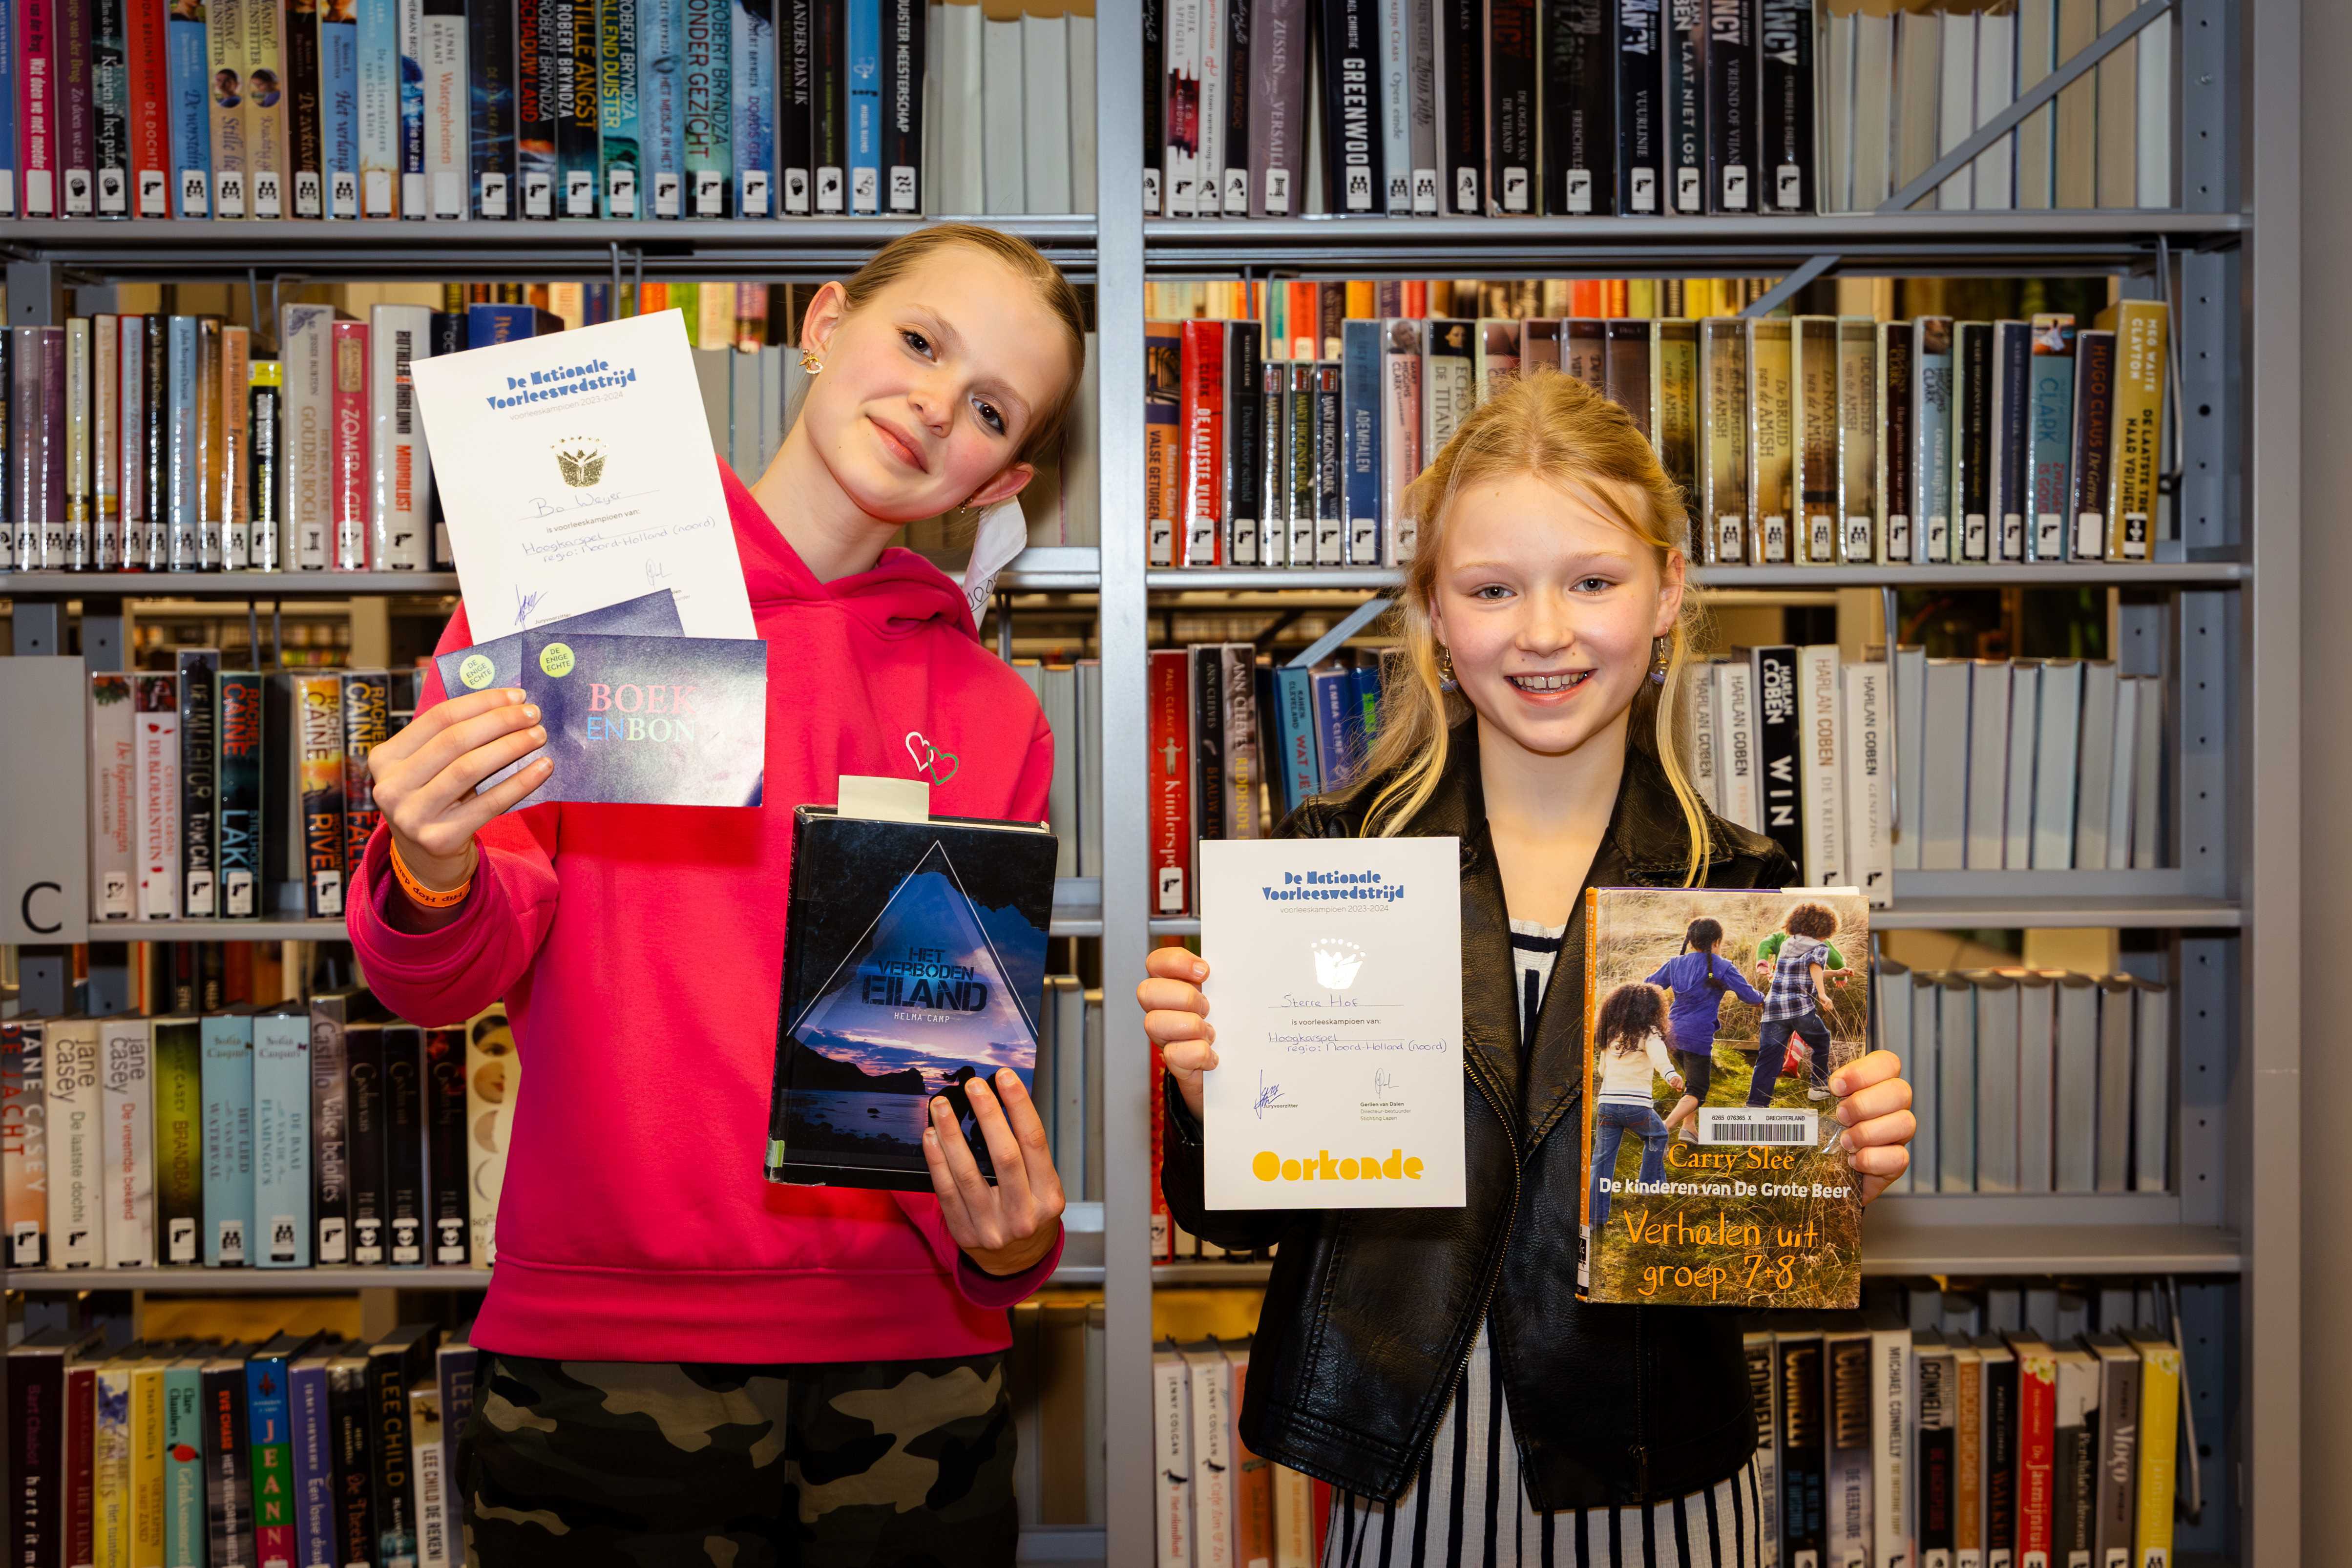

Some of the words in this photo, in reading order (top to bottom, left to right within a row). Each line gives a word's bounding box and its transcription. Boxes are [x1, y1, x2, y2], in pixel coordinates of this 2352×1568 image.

[433, 23, 443, 65] BRYANT
[445, 27, 456, 62] LYNNE
[557, 3, 573, 54] ROBERT
[30, 58, 45, 75] Wat
[794, 57, 808, 87] DAN
[1682, 42, 1694, 84] LAAT
[30, 77, 46, 99] doen
[30, 101, 44, 115] we
[521, 79, 540, 122] LAND
[539, 56, 556, 122] BRYNDZA
[558, 58, 574, 118] BRYNDZA
[574, 62, 598, 132] ANGST
[603, 61, 621, 128] DUISTER
[620, 52, 637, 121] BRYNDZA
[711, 67, 730, 146] BRYNDZA
[795, 90, 809, 105] IK
[896, 44, 911, 133] MEESTERSCHAP
[1683, 89, 1696, 127] NIET
[31, 116, 46, 134] met
[437, 71, 455, 164] Watergeheimen
[687, 73, 710, 159] GEZICHT
[1343, 58, 1369, 165] GREENWOO
[31, 136, 48, 169] moeder
[1683, 133, 1696, 165] LOS
[2130, 318, 2143, 380] CLAYTON
[2146, 319, 2158, 346] MEG
[486, 368, 637, 411] Voorleeswedstrijd
[507, 375, 527, 391] De
[530, 358, 609, 385] Nationale
[2090, 345, 2107, 394] HUGO
[2144, 352, 2156, 392] WAITE
[509, 399, 580, 422] voorleeskampioen
[580, 390, 624, 407] 2023-2024
[1197, 408, 1211, 426] DE
[1776, 398, 1789, 446] BRUID
[2036, 377, 2060, 443] CLARK
[2088, 398, 2105, 446] CLAUS
[2142, 409, 2153, 426] DE
[301, 406, 317, 475] GOUDEN
[1149, 430, 1161, 464] VALSE
[1197, 429, 1211, 479] LAATSTE
[1355, 409, 1370, 473] ADEMHALEN
[1759, 408, 1774, 458] AMISH
[2124, 418, 2138, 454] NAAR
[396, 445, 413, 512] MOORDLUST
[2139, 429, 2153, 485] LAATSTE
[543, 548, 579, 563] regio:
[672, 516, 716, 536] (noord)
[553, 513, 624, 532] voorleeskampioen
[624, 508, 641, 519] van:
[522, 533, 604, 555] Hoogkarspel
[466, 662, 487, 679] ENIGE
[468, 658, 479, 669] DE
[546, 651, 568, 664] ENIGE
[546, 659, 571, 671] ECHTE
[550, 647, 561, 655] DE
[470, 668, 493, 686] ECHTE
[1233, 661, 1246, 692] ANN
[1762, 658, 1784, 725] COBEN
[1780, 665, 1794, 715] HARLAN
[1815, 658, 1831, 714] HARLAN
[223, 683, 246, 756] CAINE
[245, 688, 260, 748] RACHEL
[345, 682, 370, 756] CAINE
[588, 683, 697, 715] BOEK
[1731, 676, 1746, 728] HARLAN
[1864, 676, 1876, 727] HARLAN
[305, 692, 327, 761] CAINE
[326, 695, 342, 753] RACHEL
[587, 715, 695, 743] ENBON
[1234, 696, 1249, 752] CLEEVES
[1818, 718, 1834, 767] COBEN
[116, 741, 132, 760] De
[148, 739, 162, 756] DE
[1296, 734, 1309, 765] WAT
[1734, 731, 1748, 776] COBEN
[1865, 731, 1877, 776] COBEN
[1235, 757, 1251, 831] REDDENDE
[1298, 772, 1311, 788] JE
[1769, 755, 1794, 827] WIN
[111, 764, 131, 853] bijenkoningin
[148, 760, 162, 861] BLOEMENTUIN
[413, 887, 436, 903] Hop
[441, 891, 463, 902] Hip
[1262, 884, 1405, 902] Voorleeswedstrijd
[1284, 871, 1302, 885] De
[1307, 870, 1382, 885] Nationale
[21, 881, 62, 935] C
[1280, 906, 1347, 914] voorleeskampioen
[1347, 904, 1389, 913] 2023-2024
[879, 960, 974, 982] VERBODEN
[908, 947, 945, 964] HET
[861, 976, 988, 1012] EILAND
[1281, 994, 1322, 1008] Sterre
[894, 1012, 923, 1022] HELMA
[927, 1014, 950, 1024] CAMP
[1268, 1032, 1339, 1044] Hoogkarspel
[1299, 1018, 1365, 1026] voorleeskampioen
[21, 1023, 45, 1091] JANE
[75, 1039, 98, 1087] jane
[104, 1037, 128, 1094] casey
[127, 1037, 148, 1080] jane
[1287, 1042, 1322, 1053] regio:
[1325, 1041, 1405, 1052] Noord-Holland
[1408, 1038, 1448, 1053] (noord)
[50, 1039, 75, 1103] casey
[2, 1069, 25, 1156] JACHT
[71, 1111, 86, 1129] De
[122, 1103, 136, 1120] De
[321, 1096, 343, 1137] Valse
[25, 1103, 46, 1192] CASEY
[72, 1134, 87, 1177] laatste
[123, 1125, 137, 1172] vreemde
[1252, 1149, 1424, 1182] Oorkonde
[1668, 1144, 1739, 1178] Carry
[1746, 1145, 1795, 1171] Slee
[321, 1140, 345, 1203] beloftes
[1599, 1177, 1622, 1194] De
[1624, 1179, 1699, 1195] kinderen
[1701, 1183, 1732, 1196] van
[1735, 1181, 1758, 1196] De
[1761, 1182, 1808, 1197] Grote
[1811, 1183, 1852, 1199] Beer
[124, 1176, 137, 1220] bekend
[1623, 1210, 1761, 1247] Verhalen
[1777, 1221, 1819, 1248] uit
[1638, 1264, 1726, 1300] groep
[380, 1371, 402, 1414] LEE
[1888, 1346, 1902, 1397] MICHAEL
[1889, 1400, 1902, 1459] CONNELLY
[383, 1418, 405, 1486] CHILD
